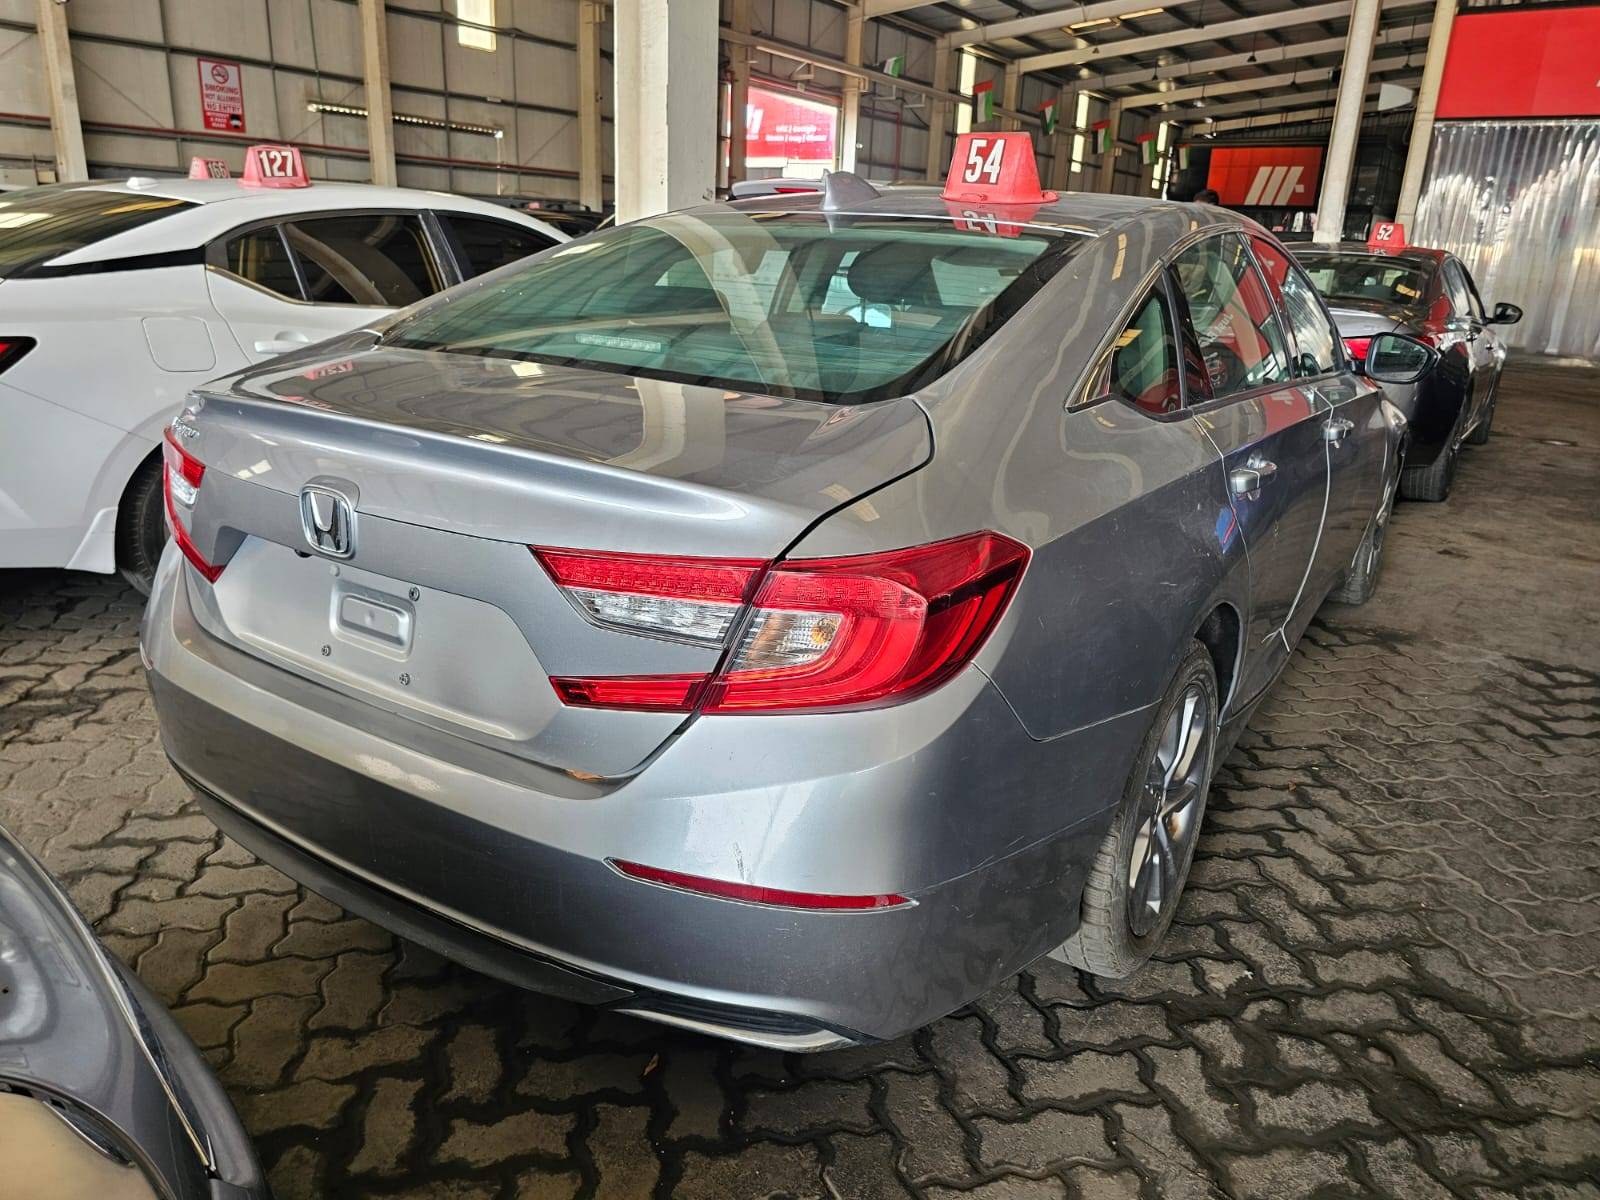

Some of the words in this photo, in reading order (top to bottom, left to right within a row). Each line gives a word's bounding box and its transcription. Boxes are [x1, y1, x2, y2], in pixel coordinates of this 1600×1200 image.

[260, 150, 293, 177] 127
[965, 139, 1005, 183] 54
[1377, 224, 1394, 240] 52
